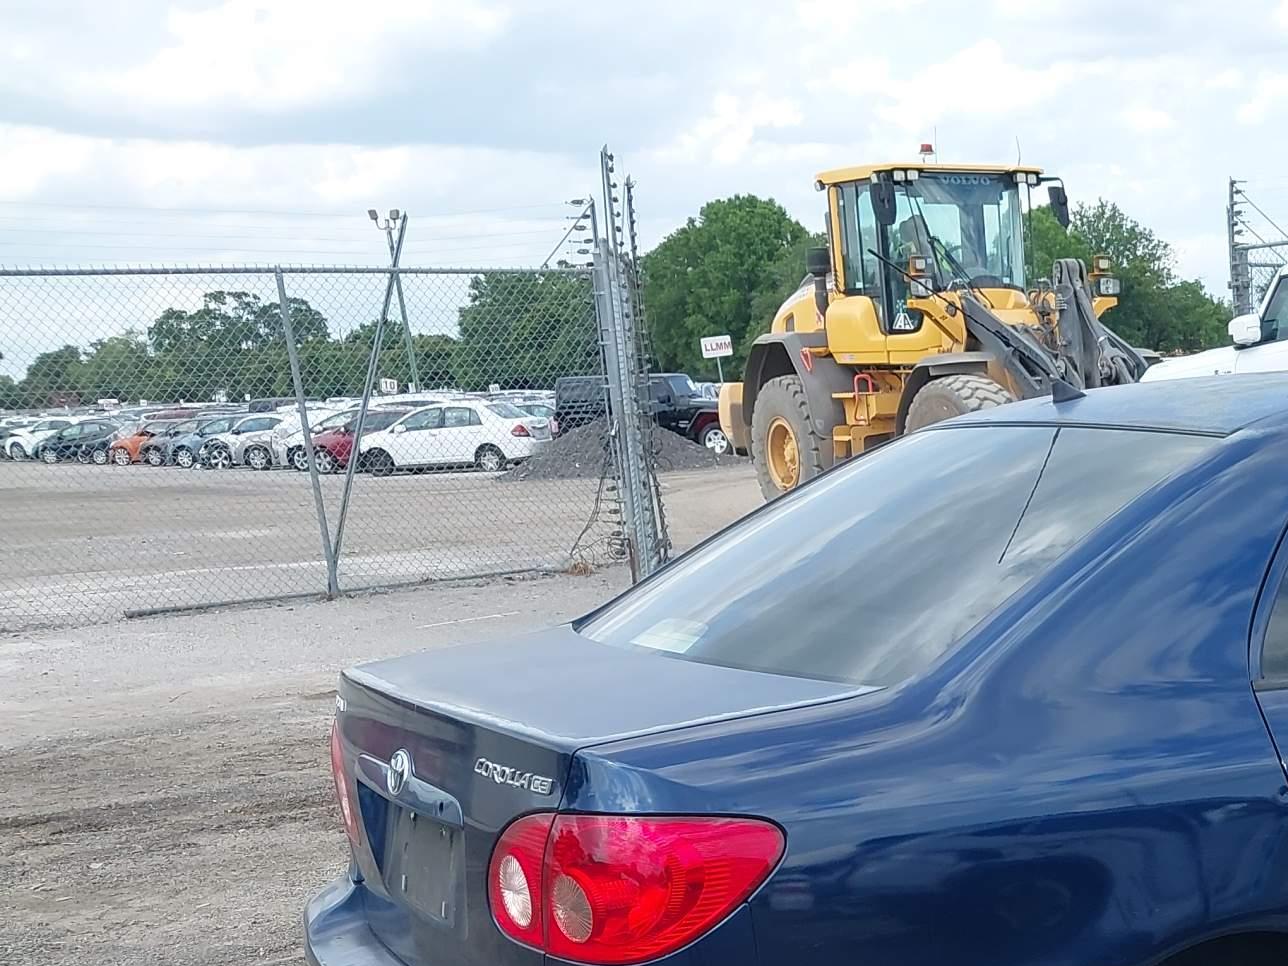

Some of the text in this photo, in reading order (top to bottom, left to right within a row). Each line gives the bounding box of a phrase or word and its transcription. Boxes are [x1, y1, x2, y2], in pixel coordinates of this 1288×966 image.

[940, 175, 990, 185] VOLVO
[474, 757, 553, 795] COROLLA CE
